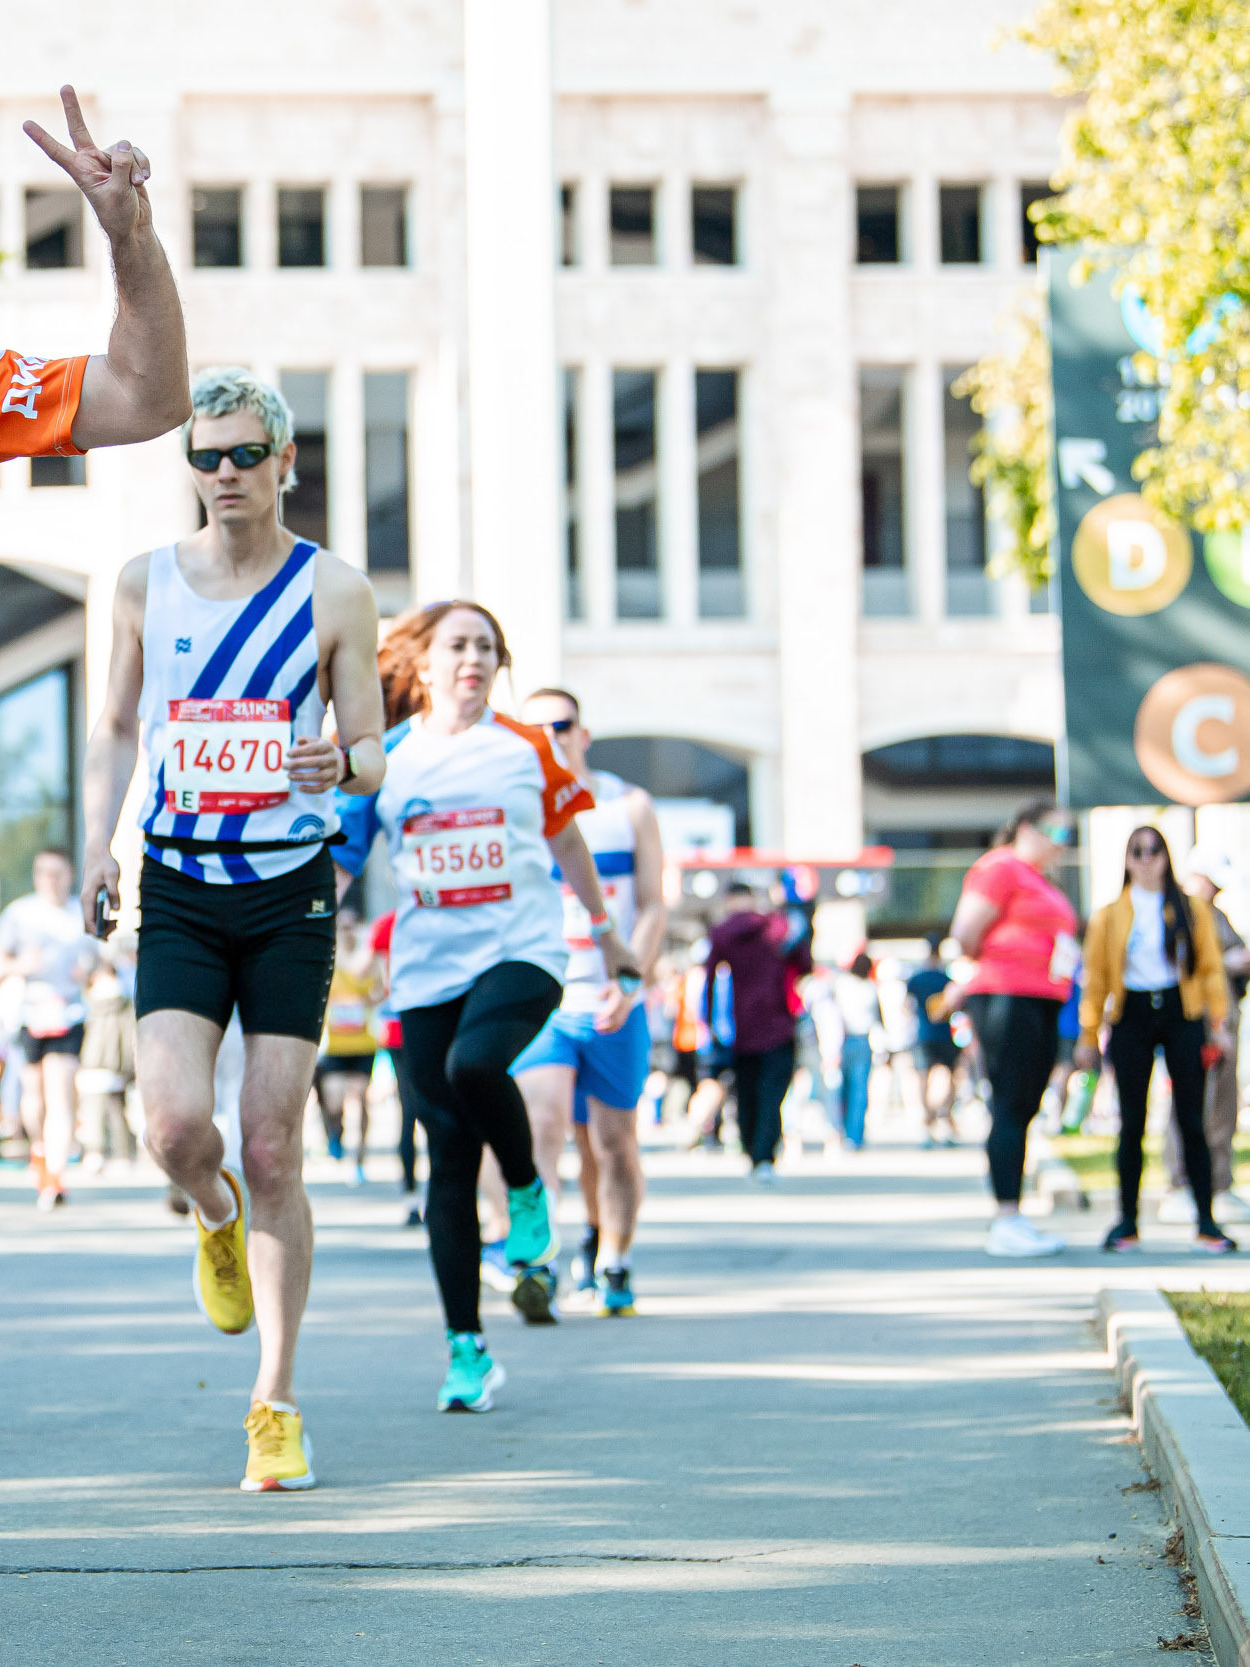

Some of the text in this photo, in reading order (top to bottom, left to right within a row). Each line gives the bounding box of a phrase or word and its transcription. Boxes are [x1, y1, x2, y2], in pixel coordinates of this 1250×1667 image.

[1, 356, 49, 419] ДИ
[1107, 520, 1167, 590] D
[173, 739, 283, 773] 14670
[1171, 693, 1239, 778] C
[182, 790, 194, 809] E
[414, 841, 504, 874] 15568
